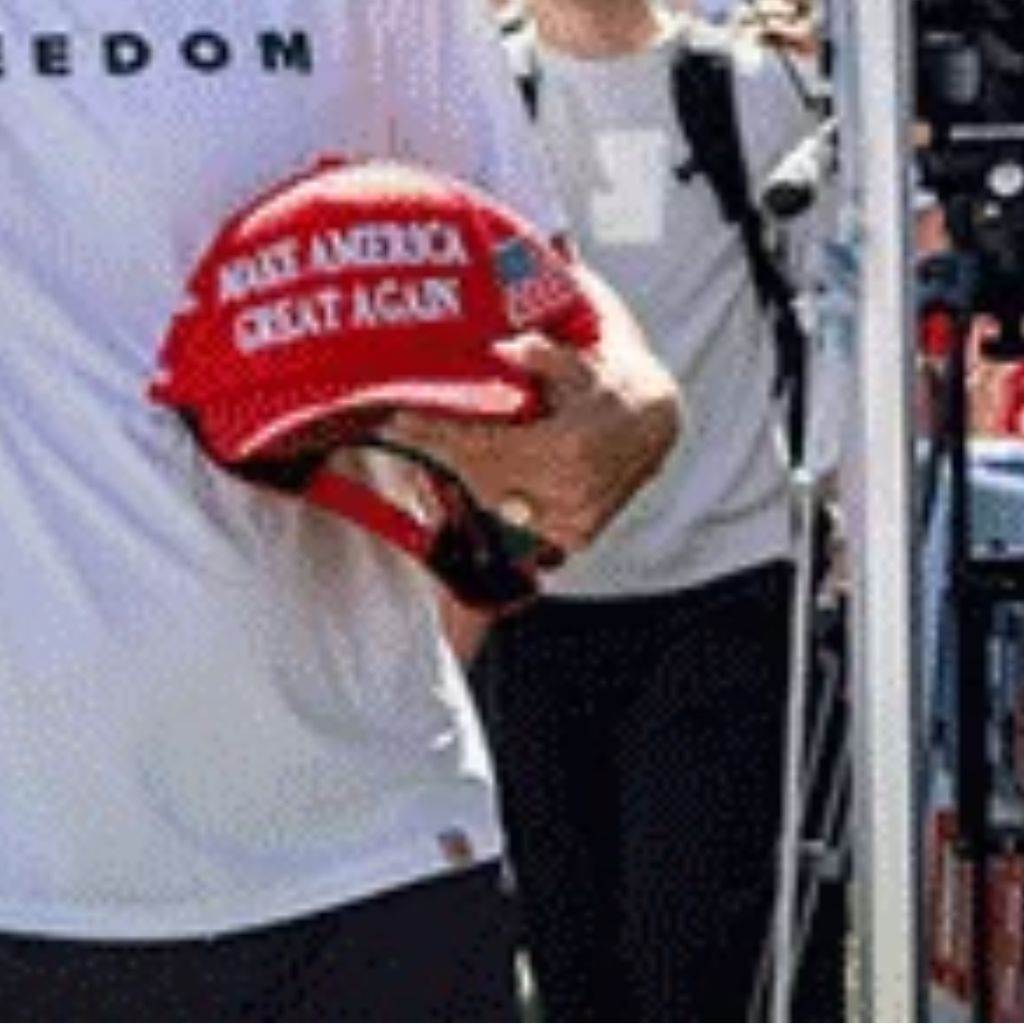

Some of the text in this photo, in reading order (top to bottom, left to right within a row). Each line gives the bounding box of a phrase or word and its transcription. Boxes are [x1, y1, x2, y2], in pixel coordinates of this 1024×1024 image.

[310, 221, 468, 270] AMERICA
[232, 278, 462, 352] GREAT AGAIN
